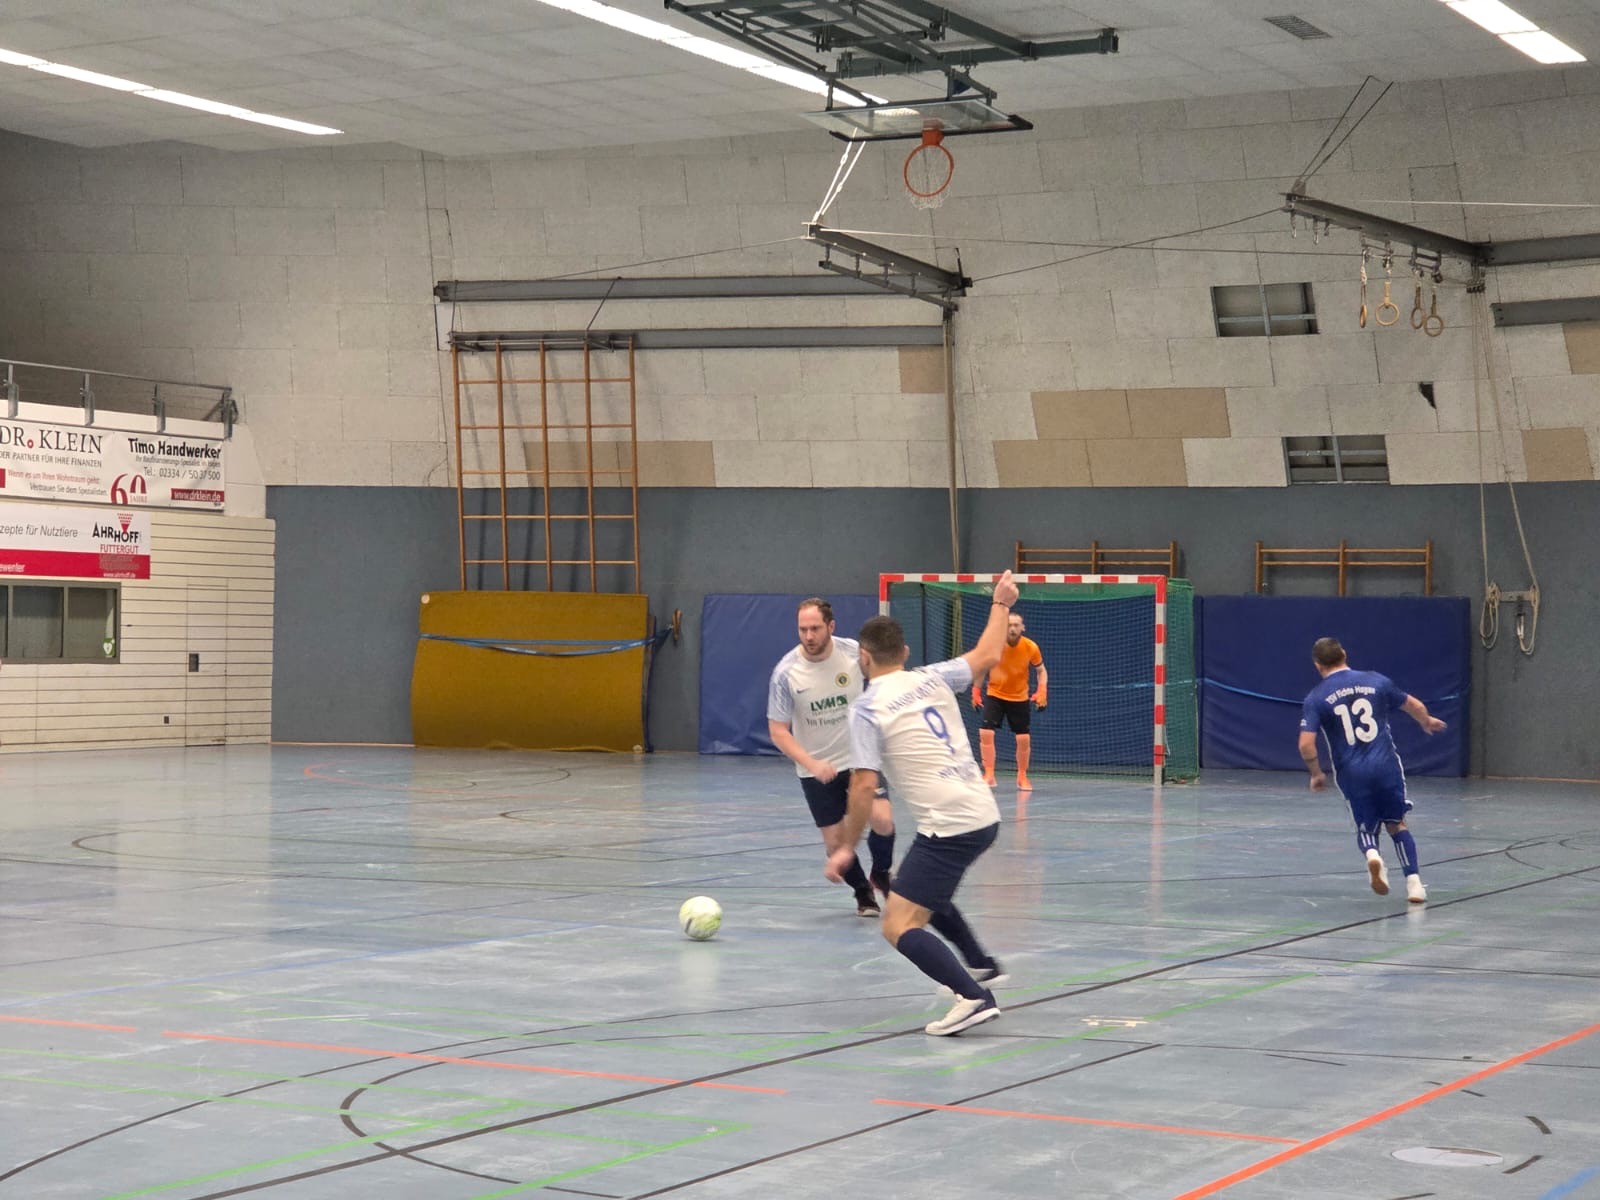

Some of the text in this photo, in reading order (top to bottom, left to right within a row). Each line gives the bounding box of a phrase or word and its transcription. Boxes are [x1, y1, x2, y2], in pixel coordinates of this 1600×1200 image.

[39, 429, 103, 454] KLEIN
[128, 438, 222, 459] Timo Handwerker
[12, 452, 40, 462] PARTNER
[41, 454, 53, 463] FÜR
[54, 456, 70, 465] IHRE
[71, 457, 102, 468] FINANZEN
[159, 468, 180, 479] 02334
[174, 490, 221, 502] www.drklein.de
[26, 524, 39, 536] für
[40, 525, 79, 538] Nutztiere
[92, 521, 139, 543] AHRHOFF
[100, 544, 139, 555] FUTTERGUT
[810, 695, 836, 711] LVM
[923, 705, 956, 755] 9
[1333, 698, 1378, 746] 13
